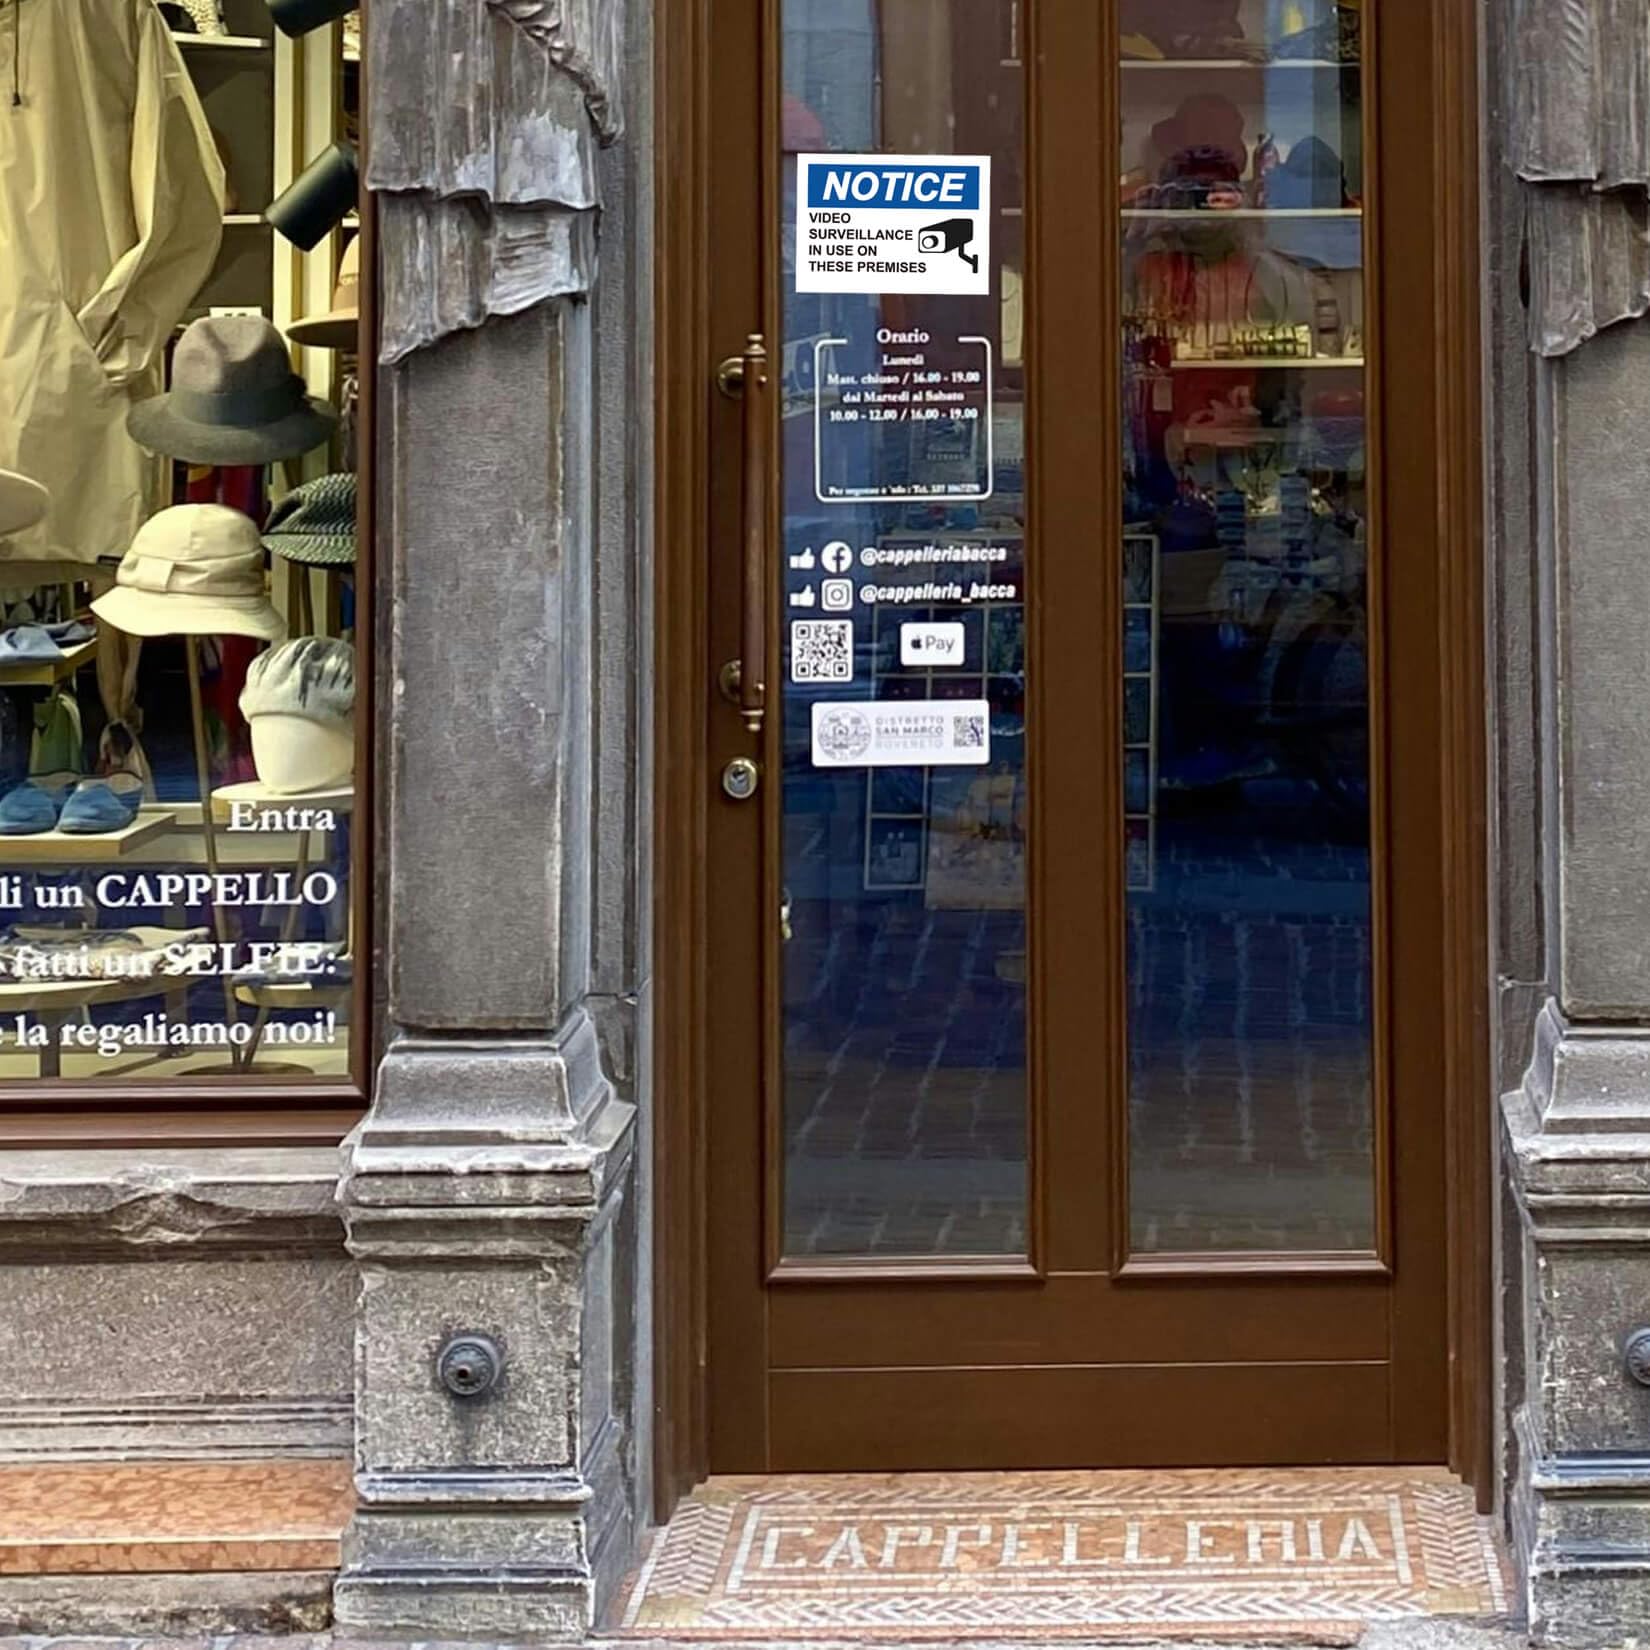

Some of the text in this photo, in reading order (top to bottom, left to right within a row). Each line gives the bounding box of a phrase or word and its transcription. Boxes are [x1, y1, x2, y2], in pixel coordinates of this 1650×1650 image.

[822, 171, 967, 202] NOTICE
[809, 212, 851, 224] VIDEO
[809, 228, 913, 240] SURVEILLANCE
[808, 244, 877, 256] IN USE ON
[808, 261, 927, 273] THESE PREMISES
[876, 328, 930, 343] Orario
[860, 372, 900, 385] chiuso
[913, 371, 941, 384] 16.00
[952, 371, 980, 384] 19.00
[842, 391, 860, 403] dal
[912, 390, 923, 402] al
[925, 389, 965, 402] Sabato
[830, 409, 858, 422] 10.00
[869, 408, 898, 421] 12.00
[911, 408, 939, 420] 16.00
[949, 407, 978, 420] 19.00
[860, 545, 1007, 566] @cappelleriabacca
[859, 582, 1016, 603] @cappelleria_bacca
[926, 636, 955, 653] Pay
[875, 726, 944, 736] SAN MARCO
[226, 800, 336, 832] Entra
[34, 884, 84, 908] un
[96, 872, 337, 908] CAPPELLO
[13, 944, 91, 977] fatti
[103, 952, 152, 977] un
[162, 942, 336, 976] SELFIE:
[14, 1010, 336, 1057] la regaliamo noi!
[760, 1518, 1384, 1568] CAPPELLERIA
